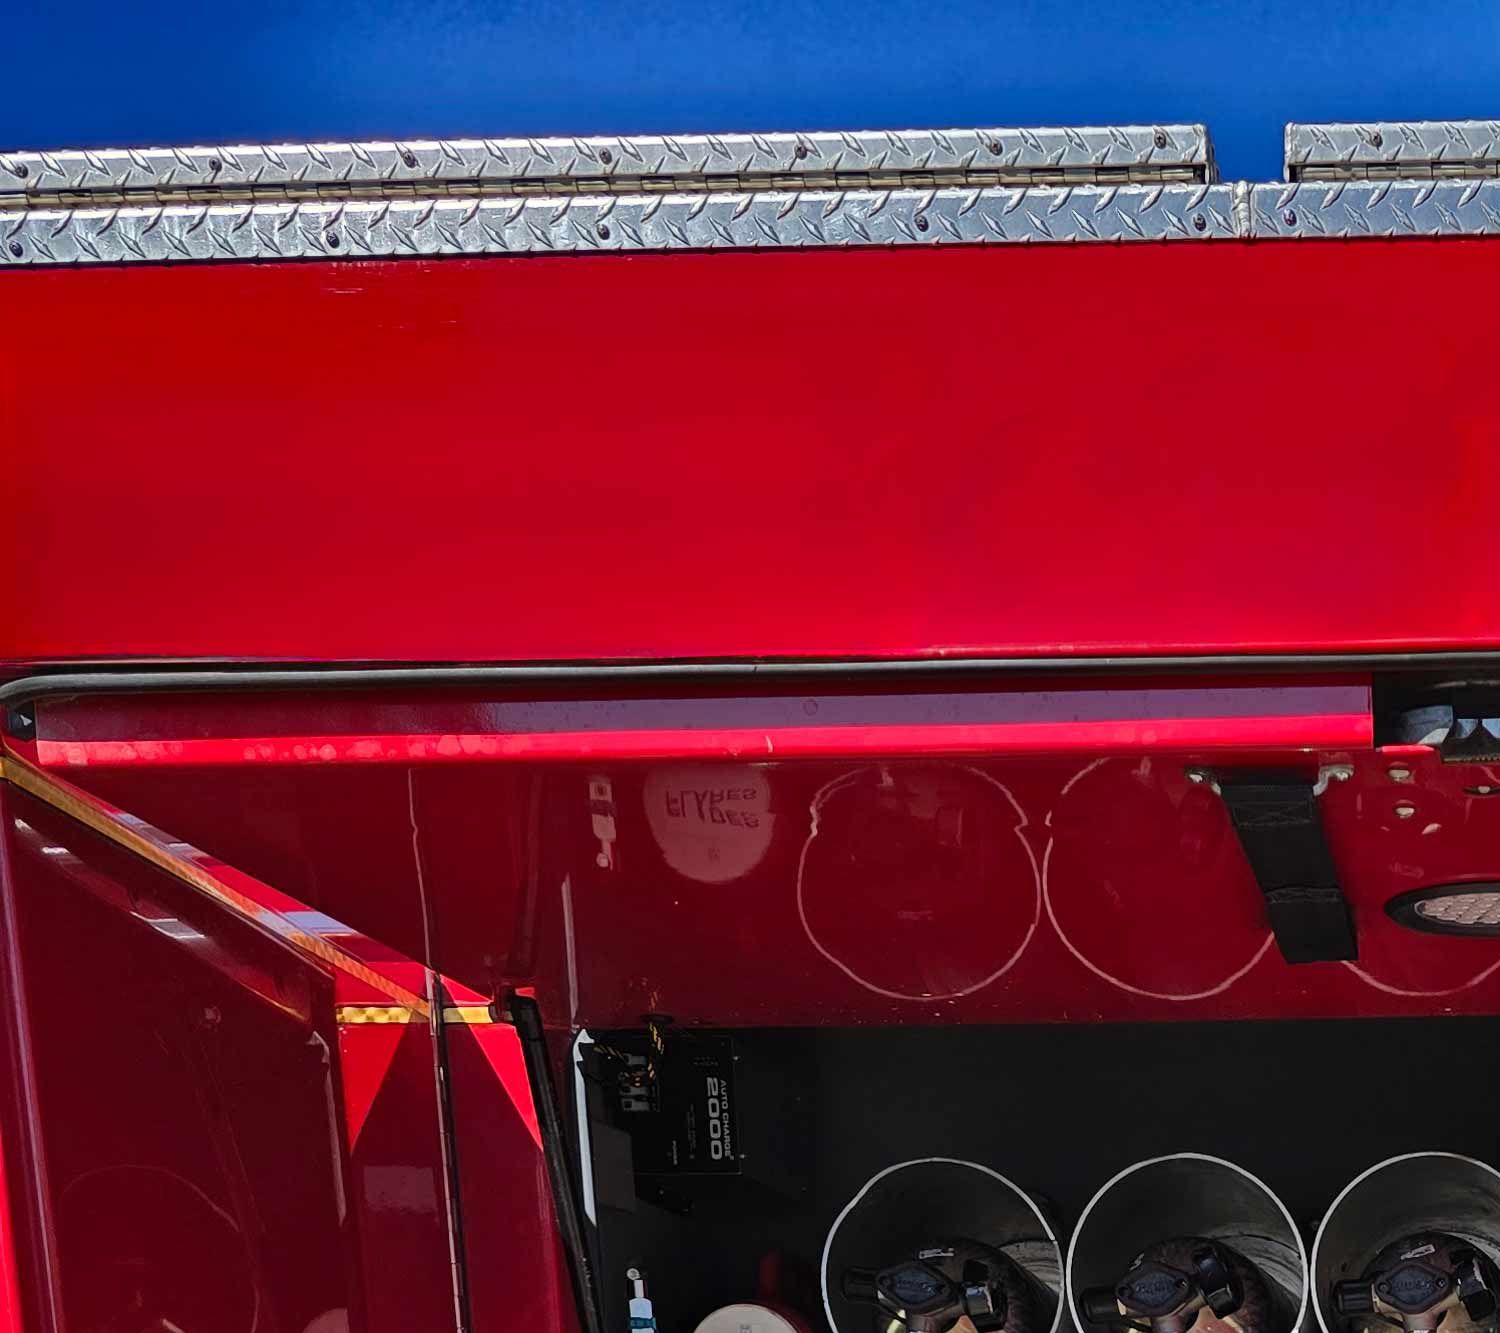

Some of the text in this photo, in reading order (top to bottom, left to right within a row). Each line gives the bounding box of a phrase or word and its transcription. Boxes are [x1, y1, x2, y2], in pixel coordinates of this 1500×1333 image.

[706, 1077, 723, 1160] 2000
[720, 1080, 732, 1157] AUTO CHARGE
